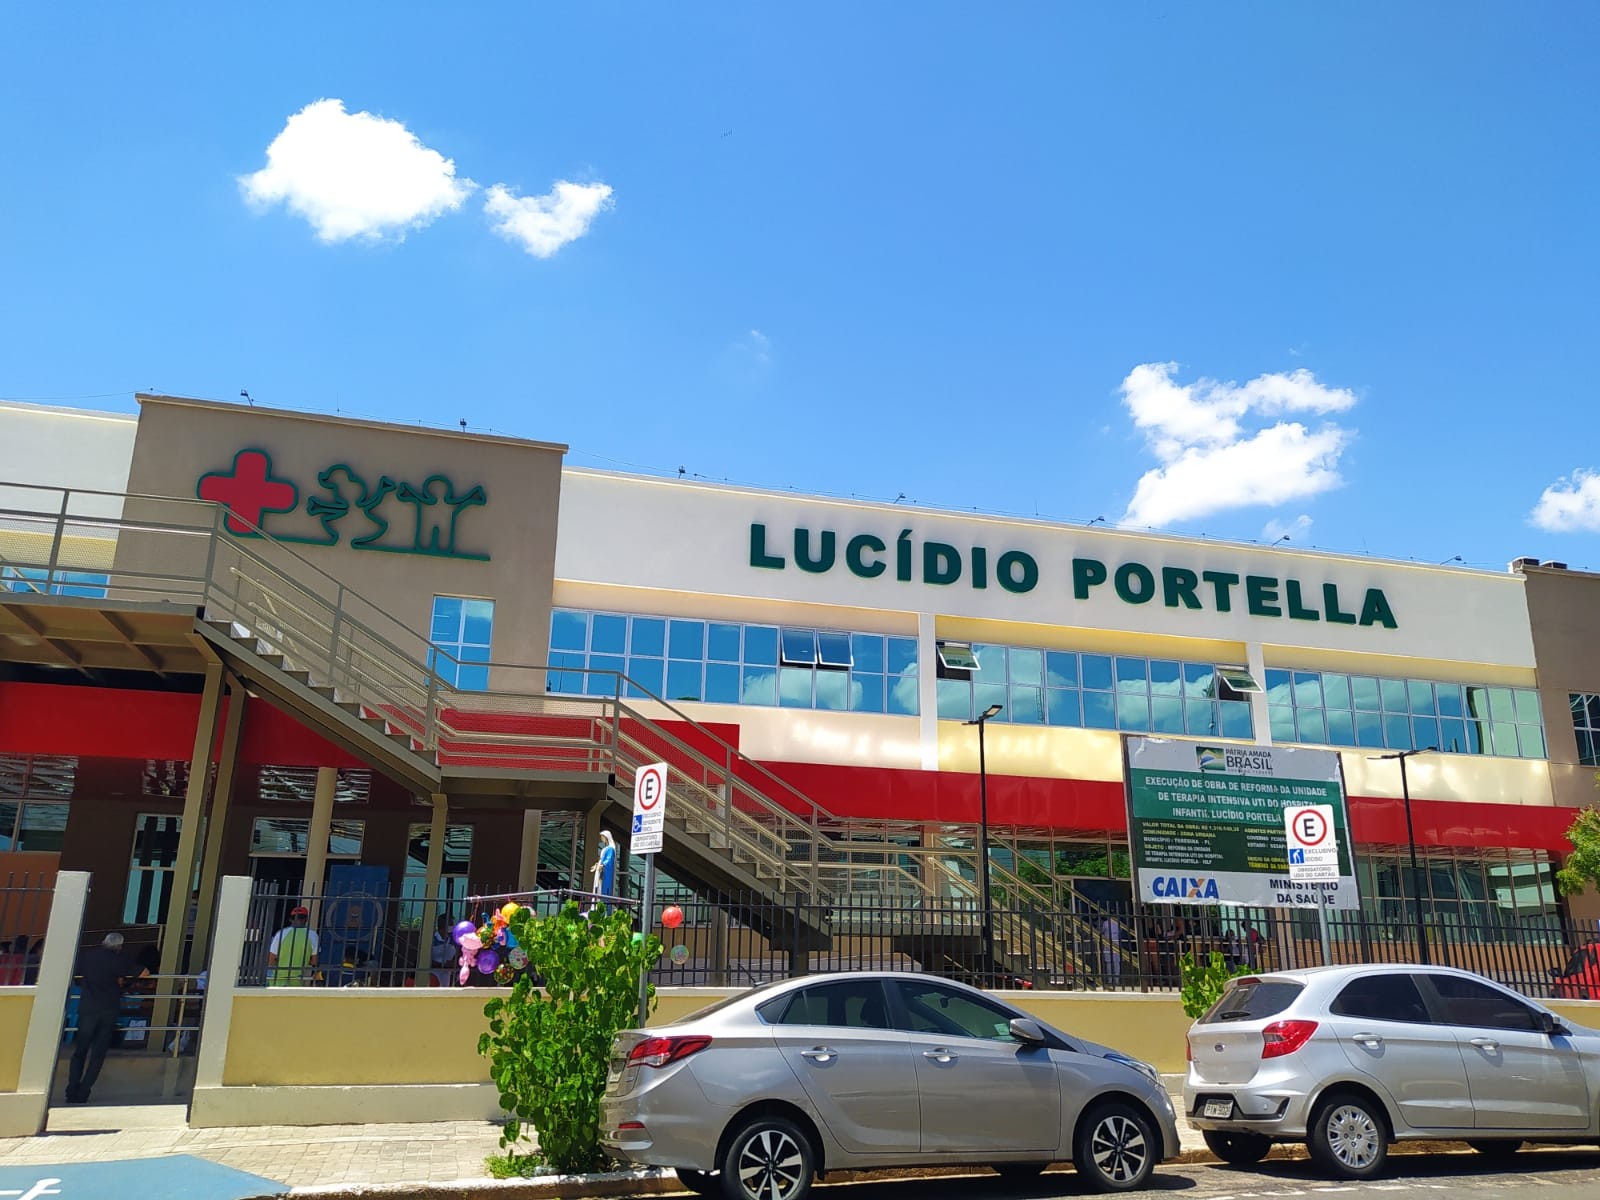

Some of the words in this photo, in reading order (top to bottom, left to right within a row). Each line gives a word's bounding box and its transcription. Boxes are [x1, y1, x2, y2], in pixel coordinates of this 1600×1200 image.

[749, 524, 1039, 594] LUCÍDIO
[1072, 558, 1399, 629] PORTELLA
[1225, 747, 1247, 756] PÁTRIA
[1249, 750, 1271, 758] AMADA
[1226, 755, 1273, 770] BRASIL
[645, 778, 654, 799] E
[1145, 776, 1189, 788] EXECUÇÃO
[1191, 779, 1203, 788] DE
[1204, 780, 1226, 790] OBRA
[1228, 782, 1239, 790] DE
[1240, 782, 1278, 793] REFORMA
[1280, 785, 1290, 794] DA
[1292, 786, 1327, 796] UNIDADE
[1158, 792, 1169, 800] DE
[1171, 792, 1206, 803] TERAPIA
[1208, 795, 1251, 806] INTENSIVA
[1252, 798, 1266, 806] UTI
[1267, 799, 1279, 808] DO
[1211, 808, 1244, 820] LUCÍDIO
[1246, 811, 1282, 822] PORTELA
[1303, 818, 1316, 837] E
[1152, 876, 1219, 899] CAIXA
[1276, 893, 1293, 903] DA
